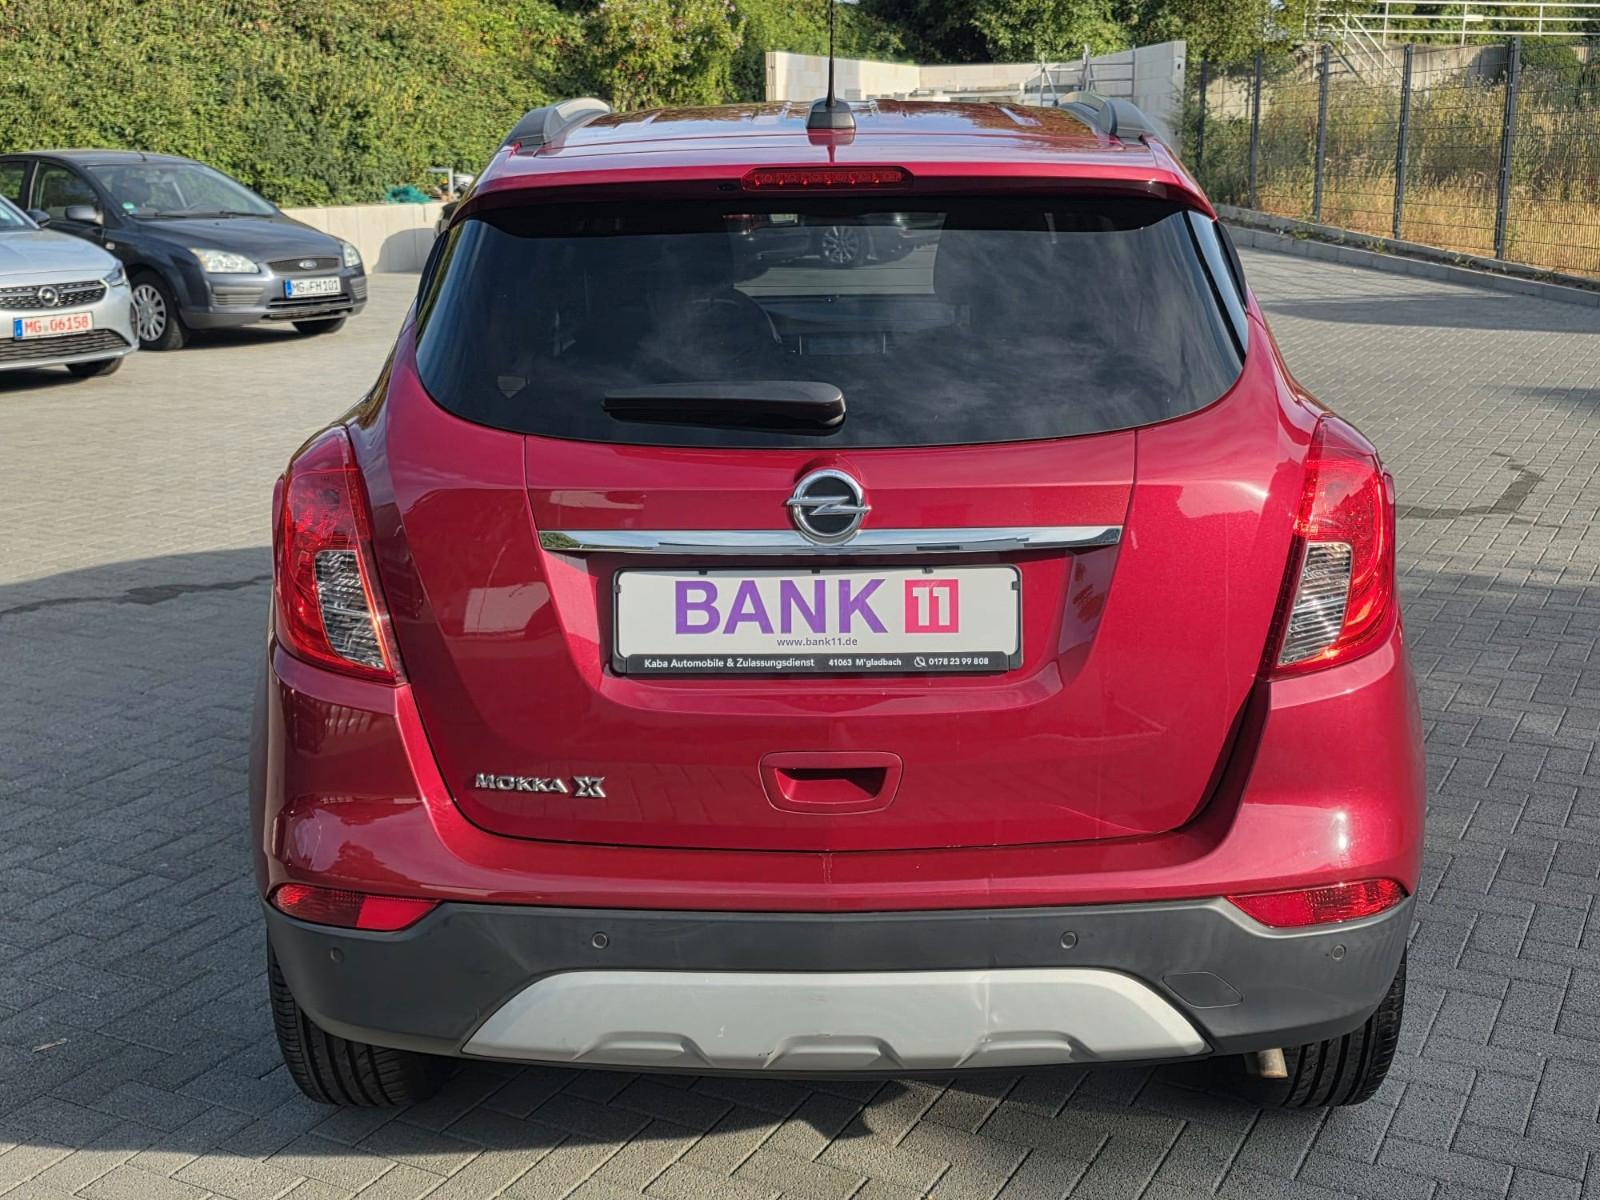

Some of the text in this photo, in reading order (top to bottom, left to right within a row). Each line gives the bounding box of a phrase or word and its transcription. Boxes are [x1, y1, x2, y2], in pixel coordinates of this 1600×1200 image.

[24, 316, 89, 333] MG 06158
[675, 578, 951, 635] BANK 11
[776, 637, 858, 647] www.bank11.de
[644, 657, 989, 669] Kaba Automobile & Zulassungsdienst 41063 M'gladbach 0178 23 99 808
[475, 772, 607, 798] MOKKA X
